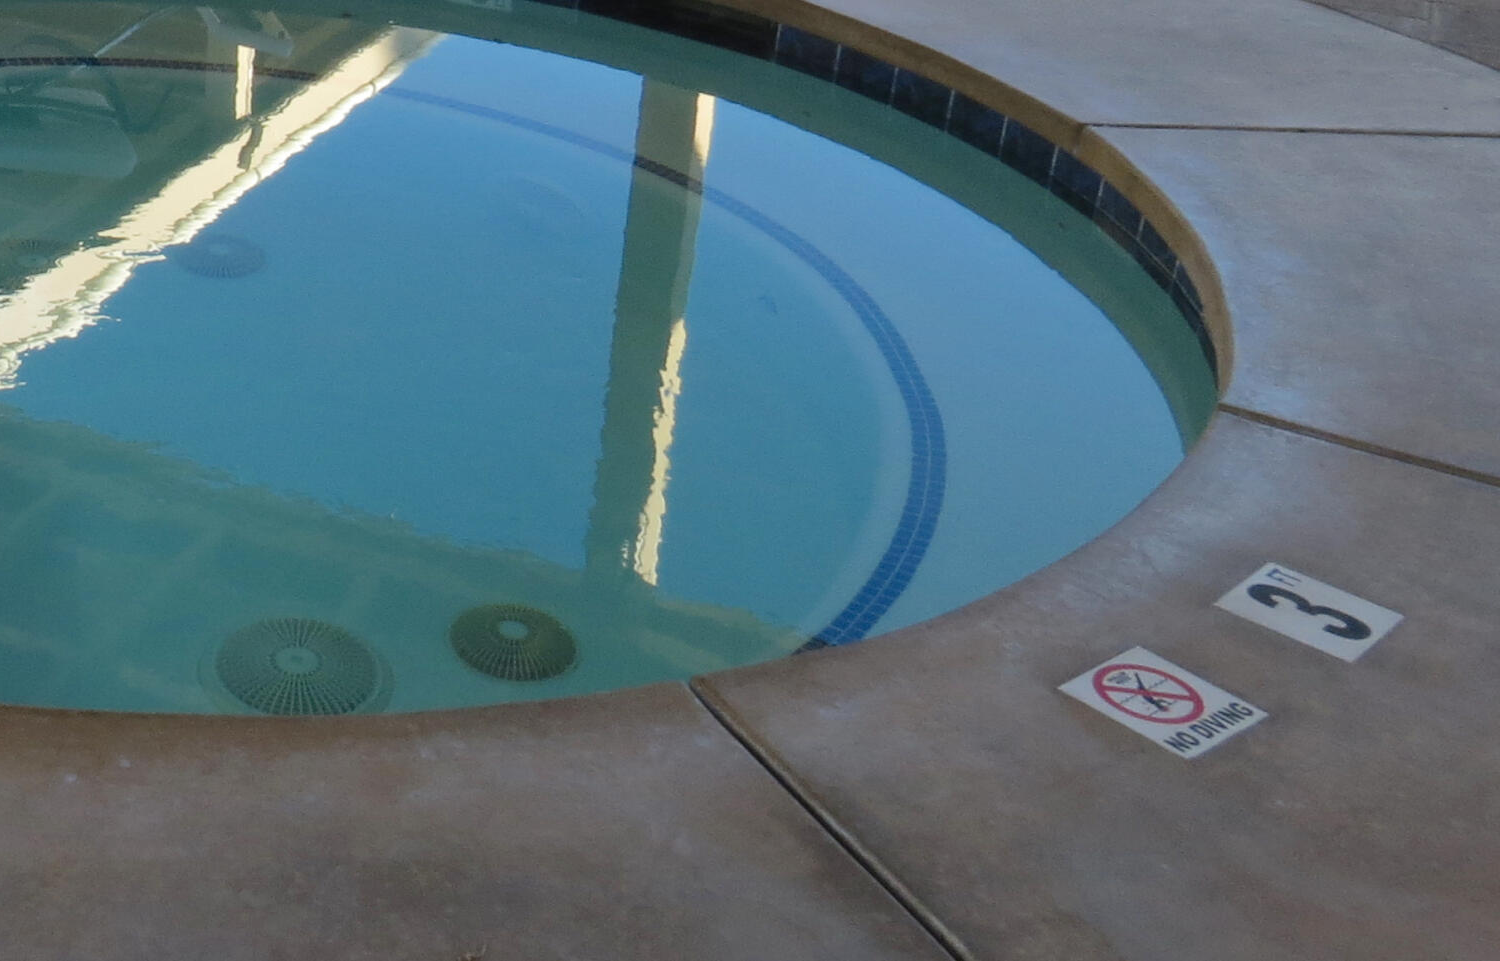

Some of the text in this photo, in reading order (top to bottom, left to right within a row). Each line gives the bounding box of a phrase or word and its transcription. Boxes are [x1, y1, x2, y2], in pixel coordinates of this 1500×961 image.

[1247, 584, 1372, 640] 3
[1163, 701, 1255, 753] NO DIVING
